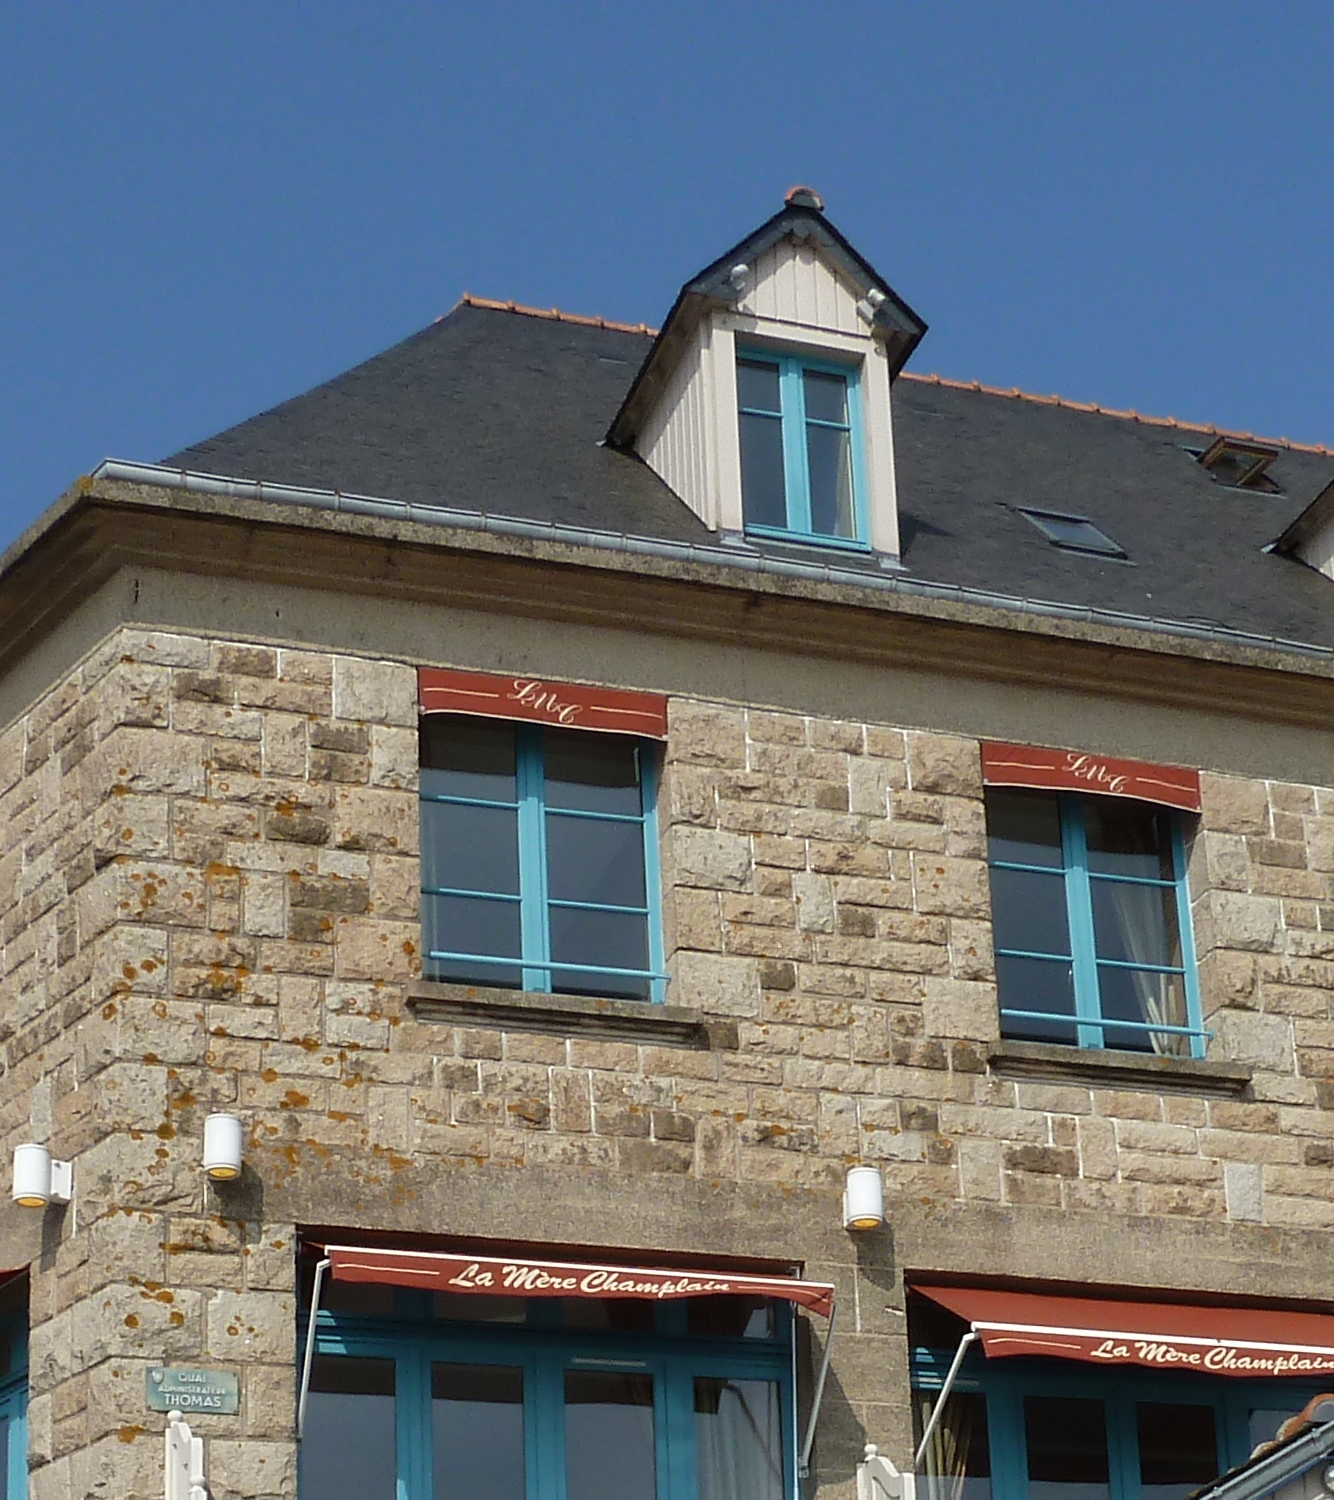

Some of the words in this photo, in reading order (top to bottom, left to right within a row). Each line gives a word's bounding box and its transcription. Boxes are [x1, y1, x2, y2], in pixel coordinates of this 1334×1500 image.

[448, 1264, 495, 1288] La
[502, 1265, 577, 1290] Mère
[580, 1271, 731, 1300] Champlain
[1090, 1340, 1131, 1358] La
[1135, 1342, 1201, 1365] Mère
[178, 1373, 206, 1383] QUAI
[158, 1385, 227, 1395] ADMINISTRATEUR
[164, 1394, 221, 1407] THOMAS
